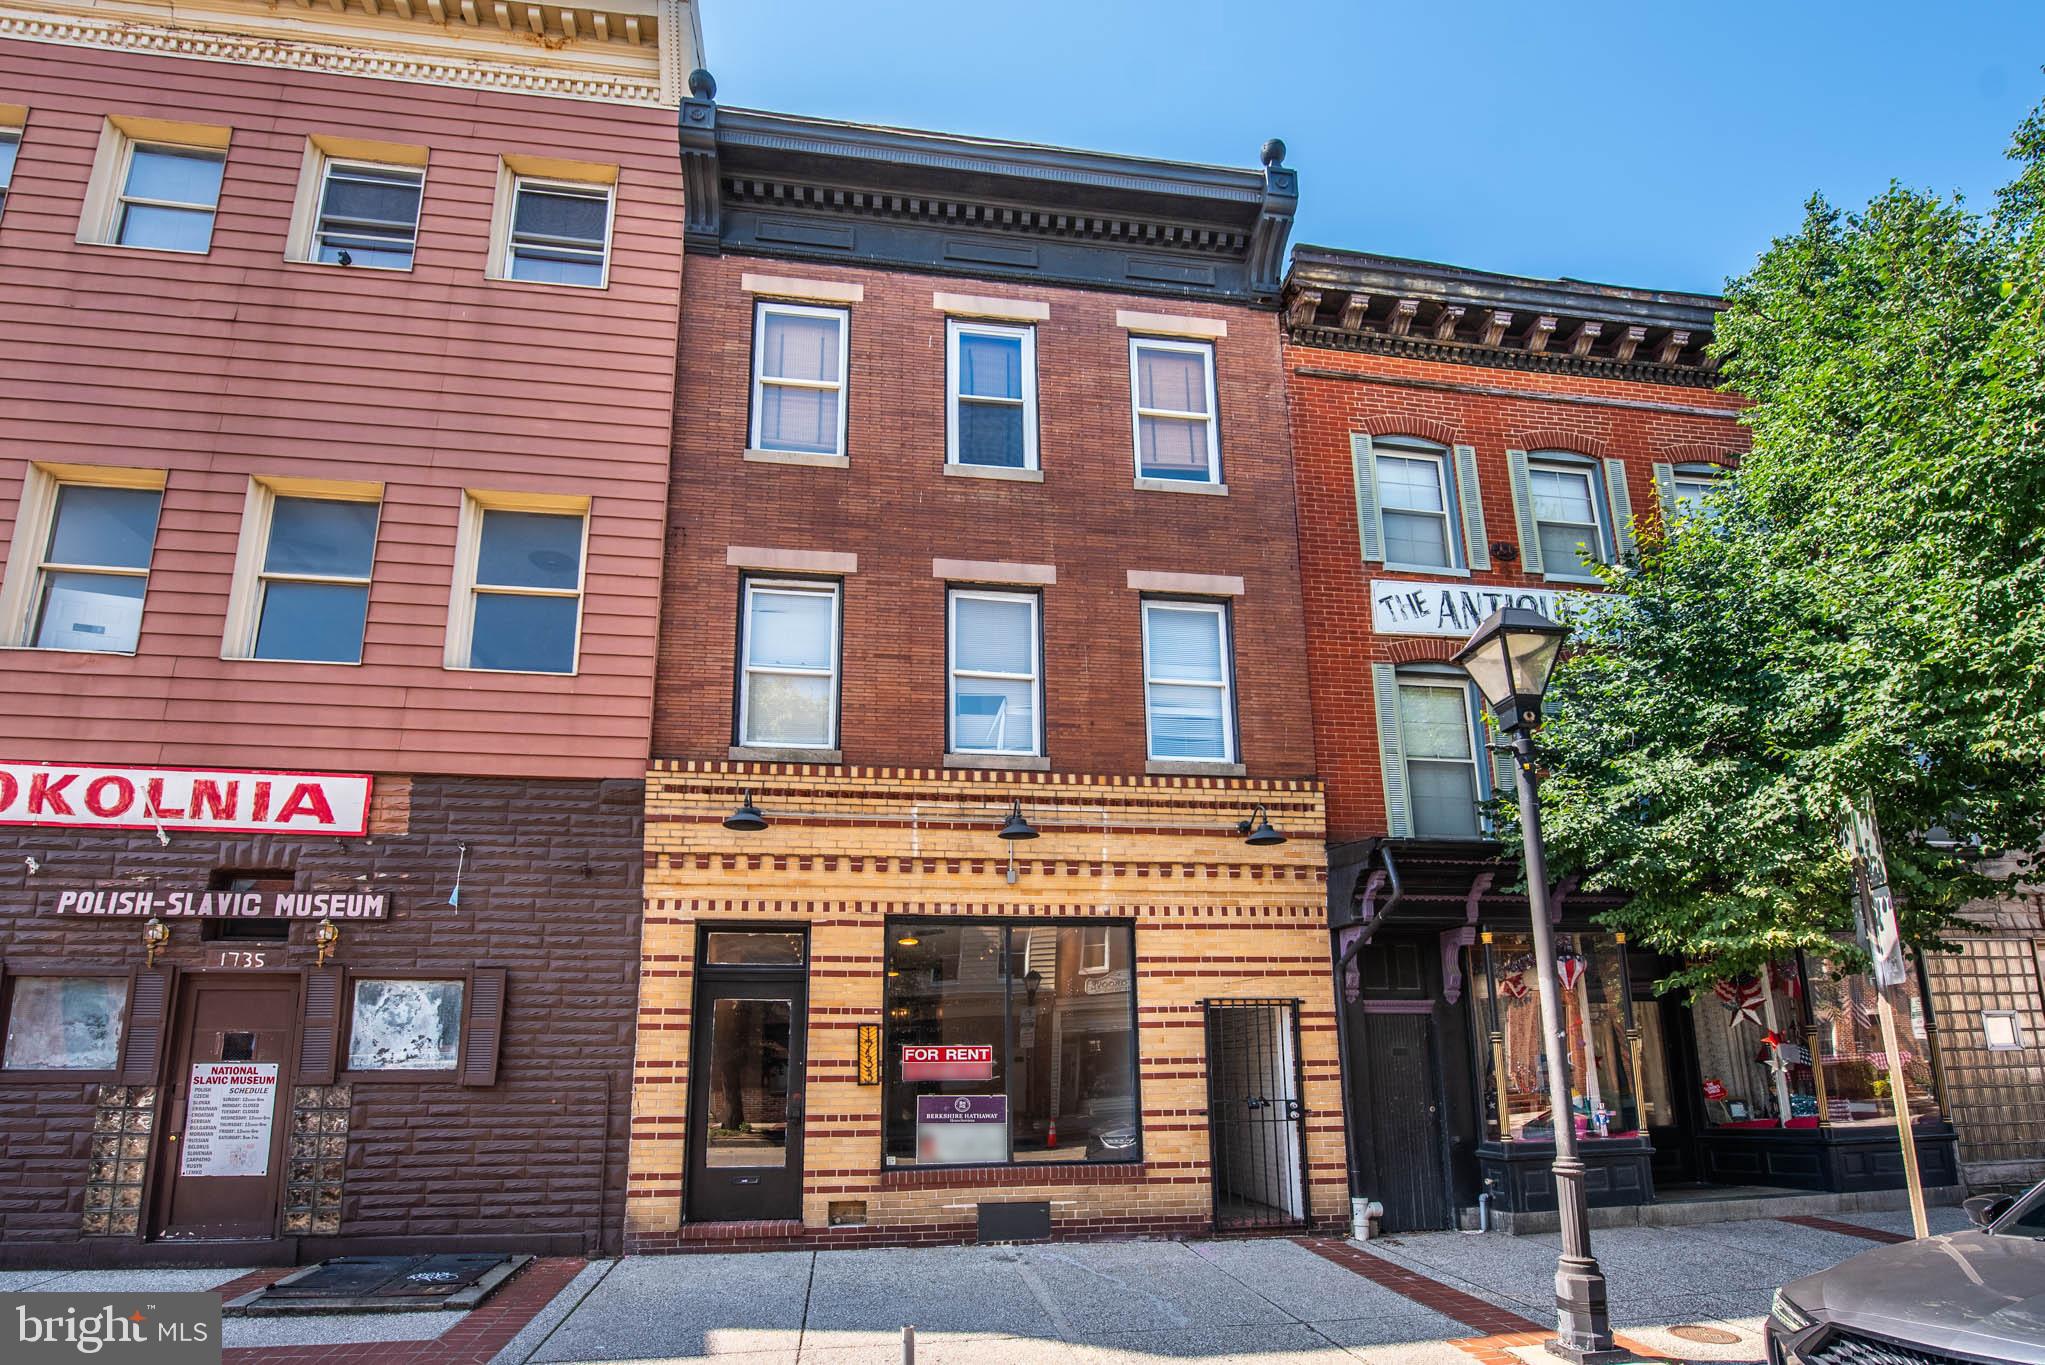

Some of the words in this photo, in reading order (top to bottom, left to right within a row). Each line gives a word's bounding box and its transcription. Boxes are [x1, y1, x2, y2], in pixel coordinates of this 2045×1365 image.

[1379, 589, 1431, 623] THE
[57, 891, 260, 916] POLISH-SLAVIC
[274, 894, 384, 917] MUSEUM
[219, 951, 266, 967] 1735
[904, 1049, 939, 1061] FOR
[945, 1049, 990, 1061] RENT
[211, 1066, 259, 1075] NATIONAL
[193, 1076, 228, 1085] SLAVIC
[230, 1076, 276, 1085] MUSEUM
